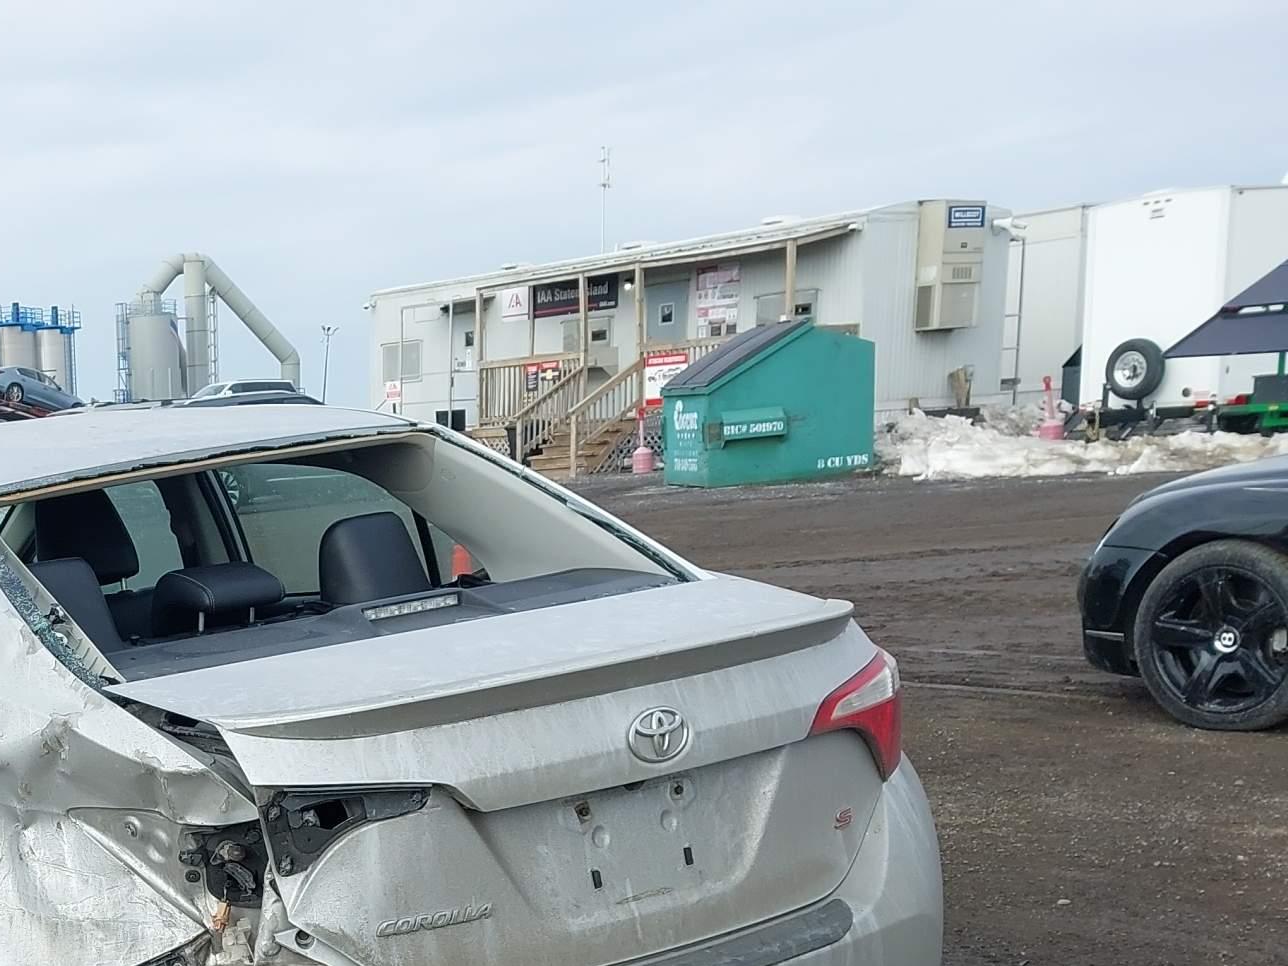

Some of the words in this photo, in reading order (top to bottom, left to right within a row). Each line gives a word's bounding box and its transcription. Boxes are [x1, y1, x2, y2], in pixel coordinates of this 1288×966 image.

[537, 290, 552, 304] IAA
[724, 424, 747, 435] BIC#
[749, 421, 784, 433] 501970
[817, 458, 825, 469] 8
[827, 456, 843, 468] CU
[846, 453, 869, 466] YDS
[376, 902, 493, 938] COROLLA
